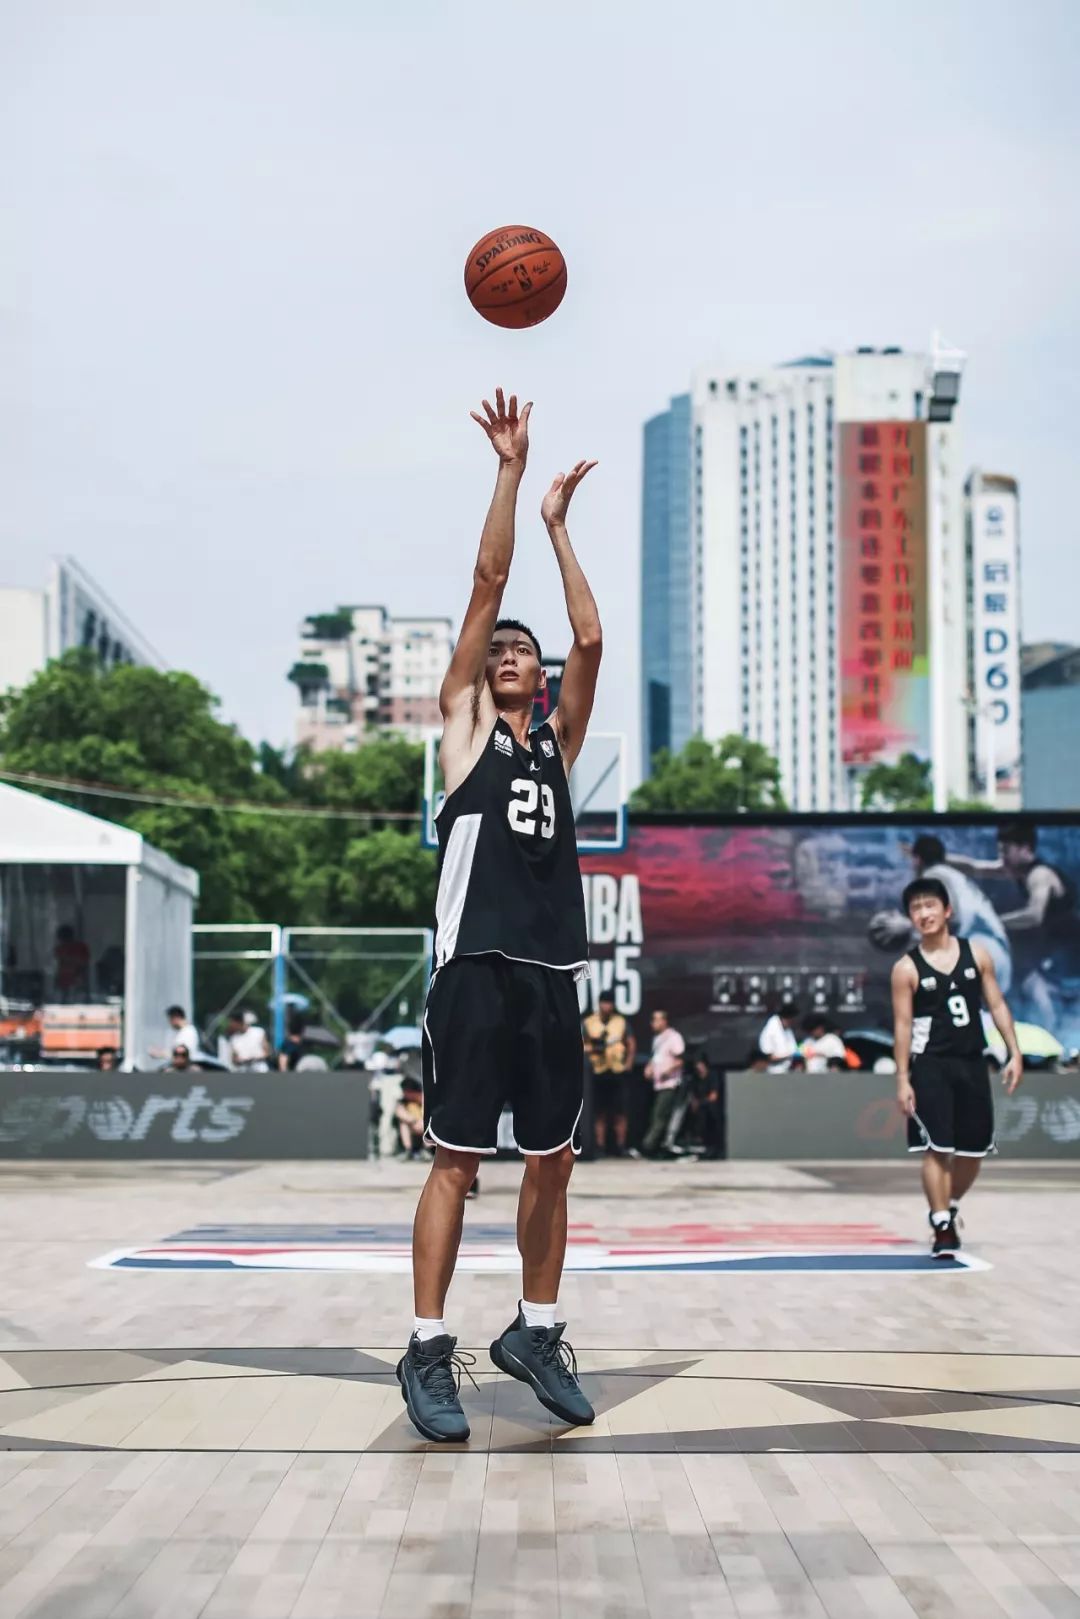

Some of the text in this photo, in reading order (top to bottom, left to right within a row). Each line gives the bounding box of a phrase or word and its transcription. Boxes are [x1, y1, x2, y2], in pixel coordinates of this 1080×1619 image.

[476, 232, 543, 272] SPALDING
[507, 778, 556, 839] 29
[947, 995, 970, 1028] 9
